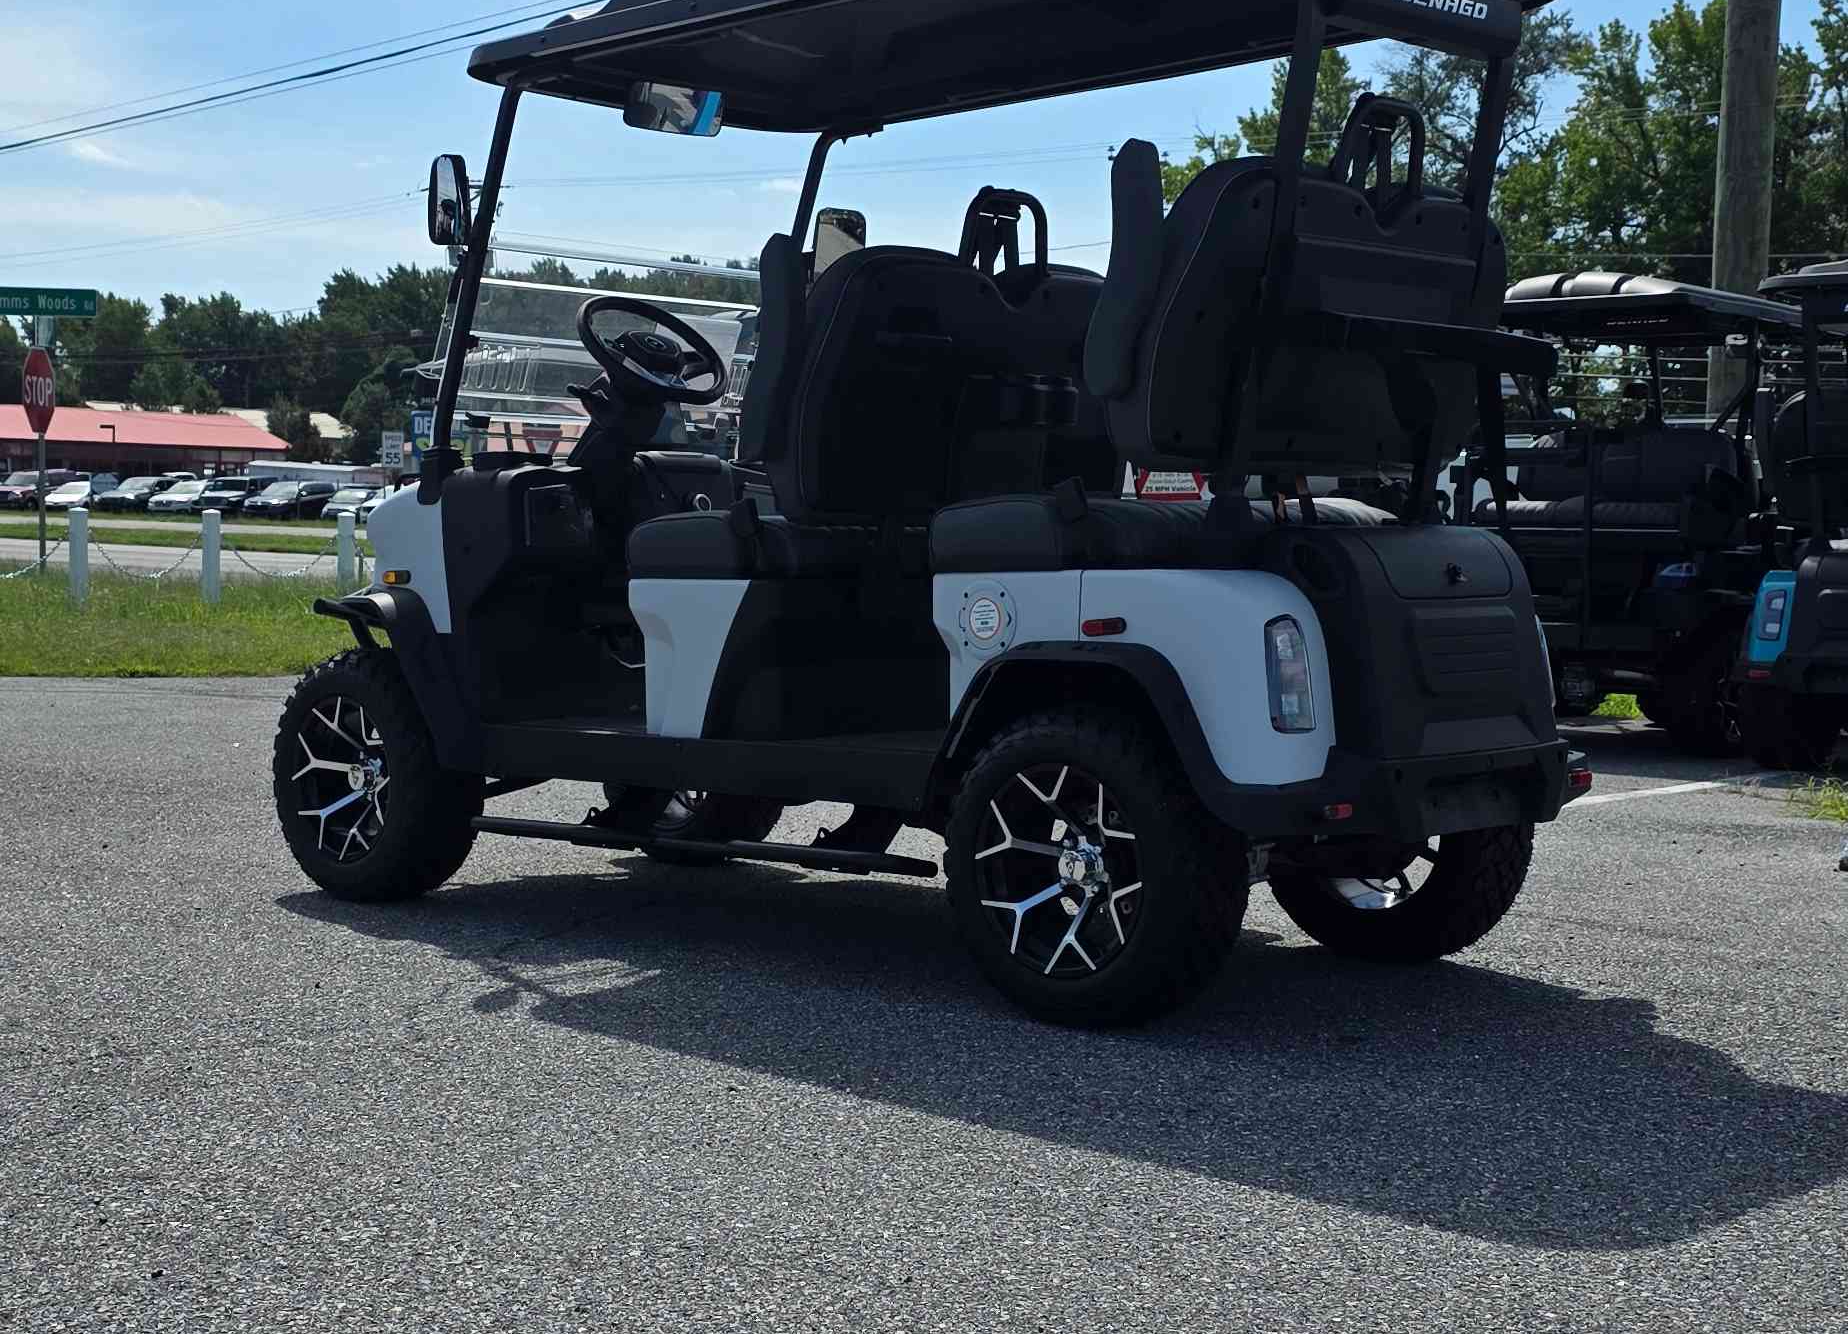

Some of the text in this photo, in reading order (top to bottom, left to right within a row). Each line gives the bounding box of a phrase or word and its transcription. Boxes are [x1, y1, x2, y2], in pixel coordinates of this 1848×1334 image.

[38, 294, 77, 310] Woods
[24, 375, 53, 407] STOP
[384, 452, 401, 465] 55
